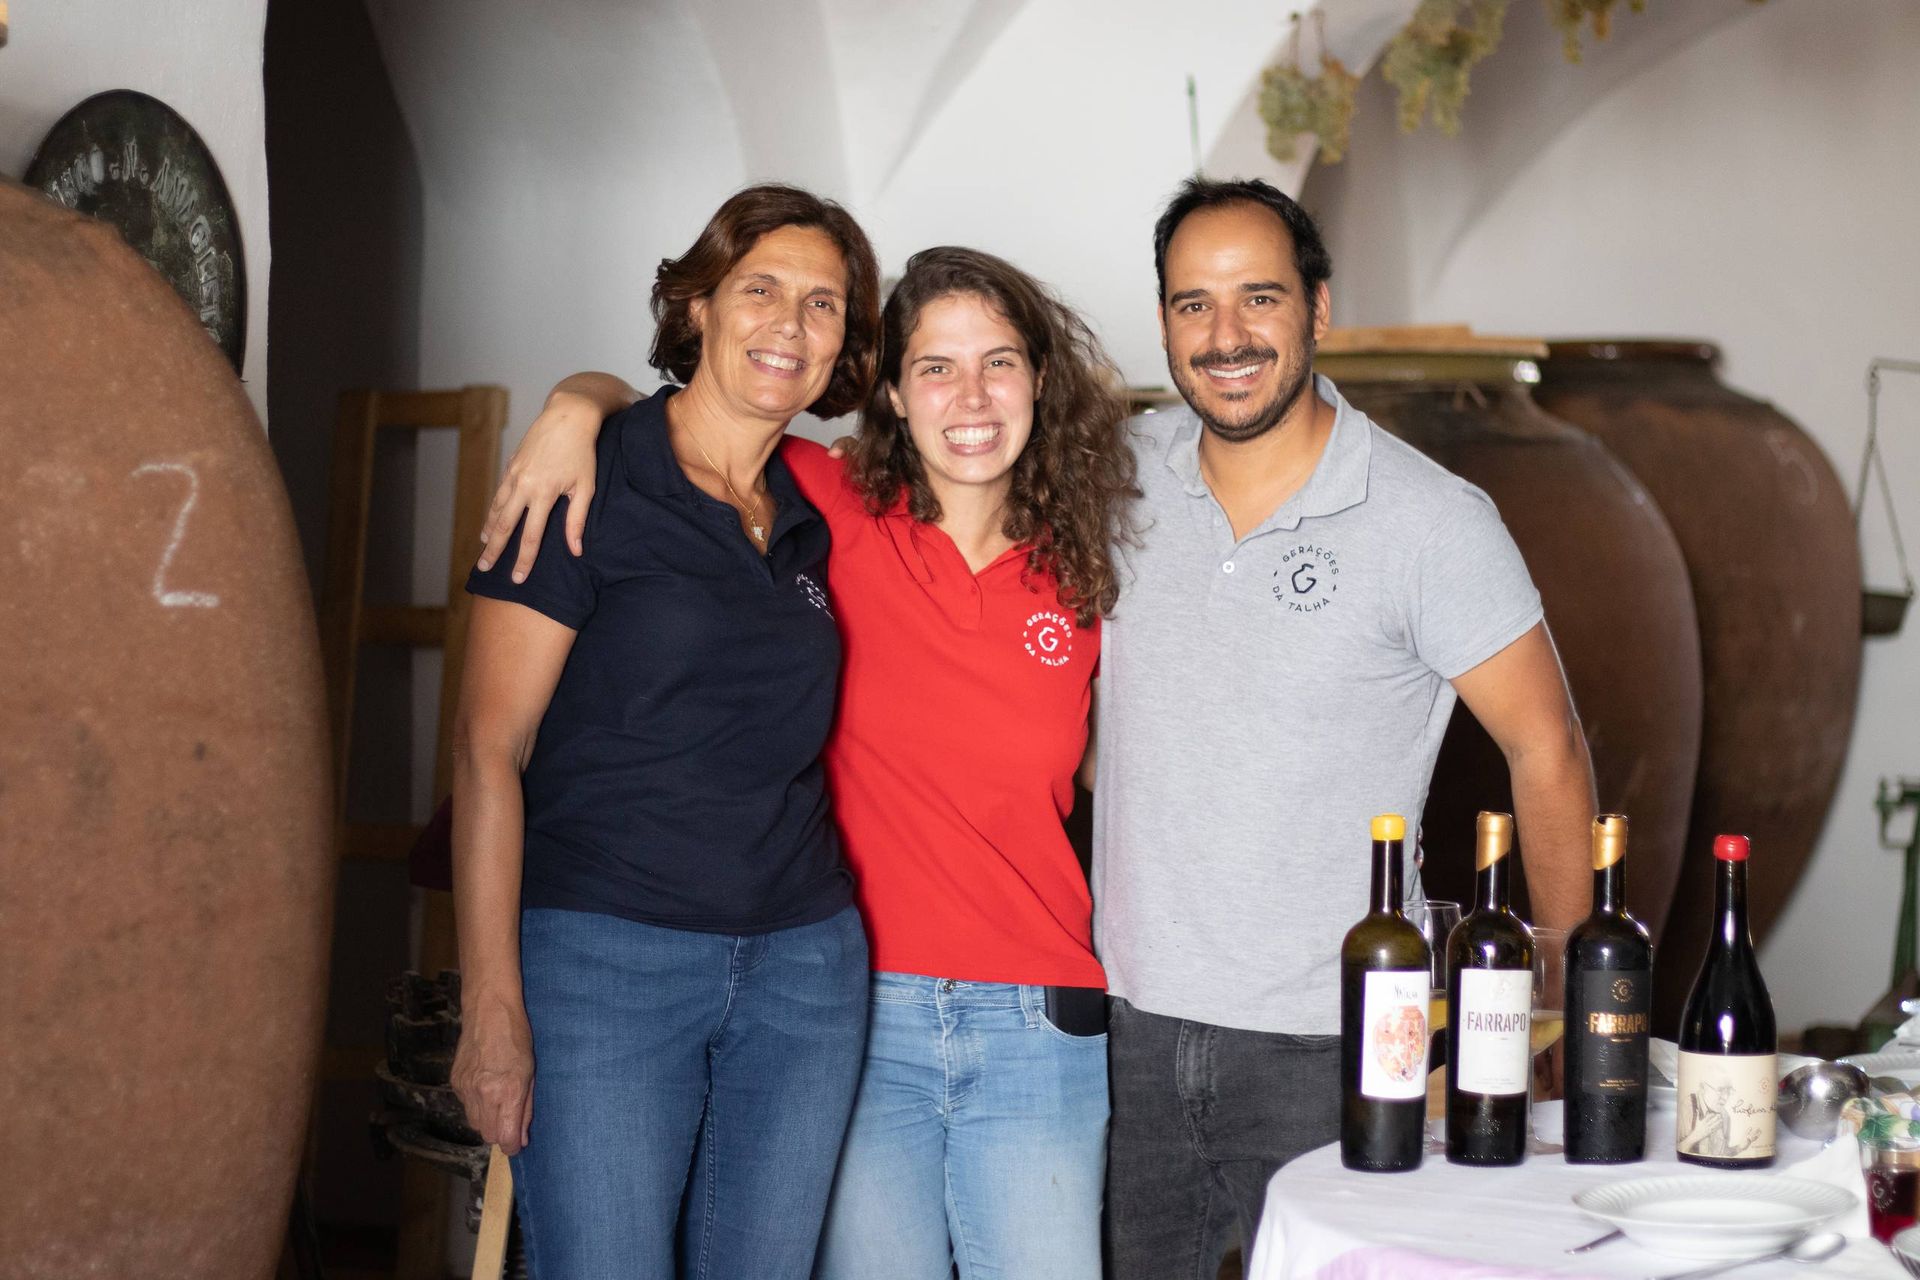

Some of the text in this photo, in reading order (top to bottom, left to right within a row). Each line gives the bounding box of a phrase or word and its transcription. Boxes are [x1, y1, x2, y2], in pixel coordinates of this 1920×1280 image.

[130, 463, 220, 608] 2
[1282, 545, 1339, 575] GERAÇÕES
[1291, 563, 1317, 594] G
[1272, 585, 1284, 602] DA
[1288, 597, 1331, 612] TALHA
[1038, 626, 1059, 652] G
[1467, 1011, 1527, 1032] FARRAPO
